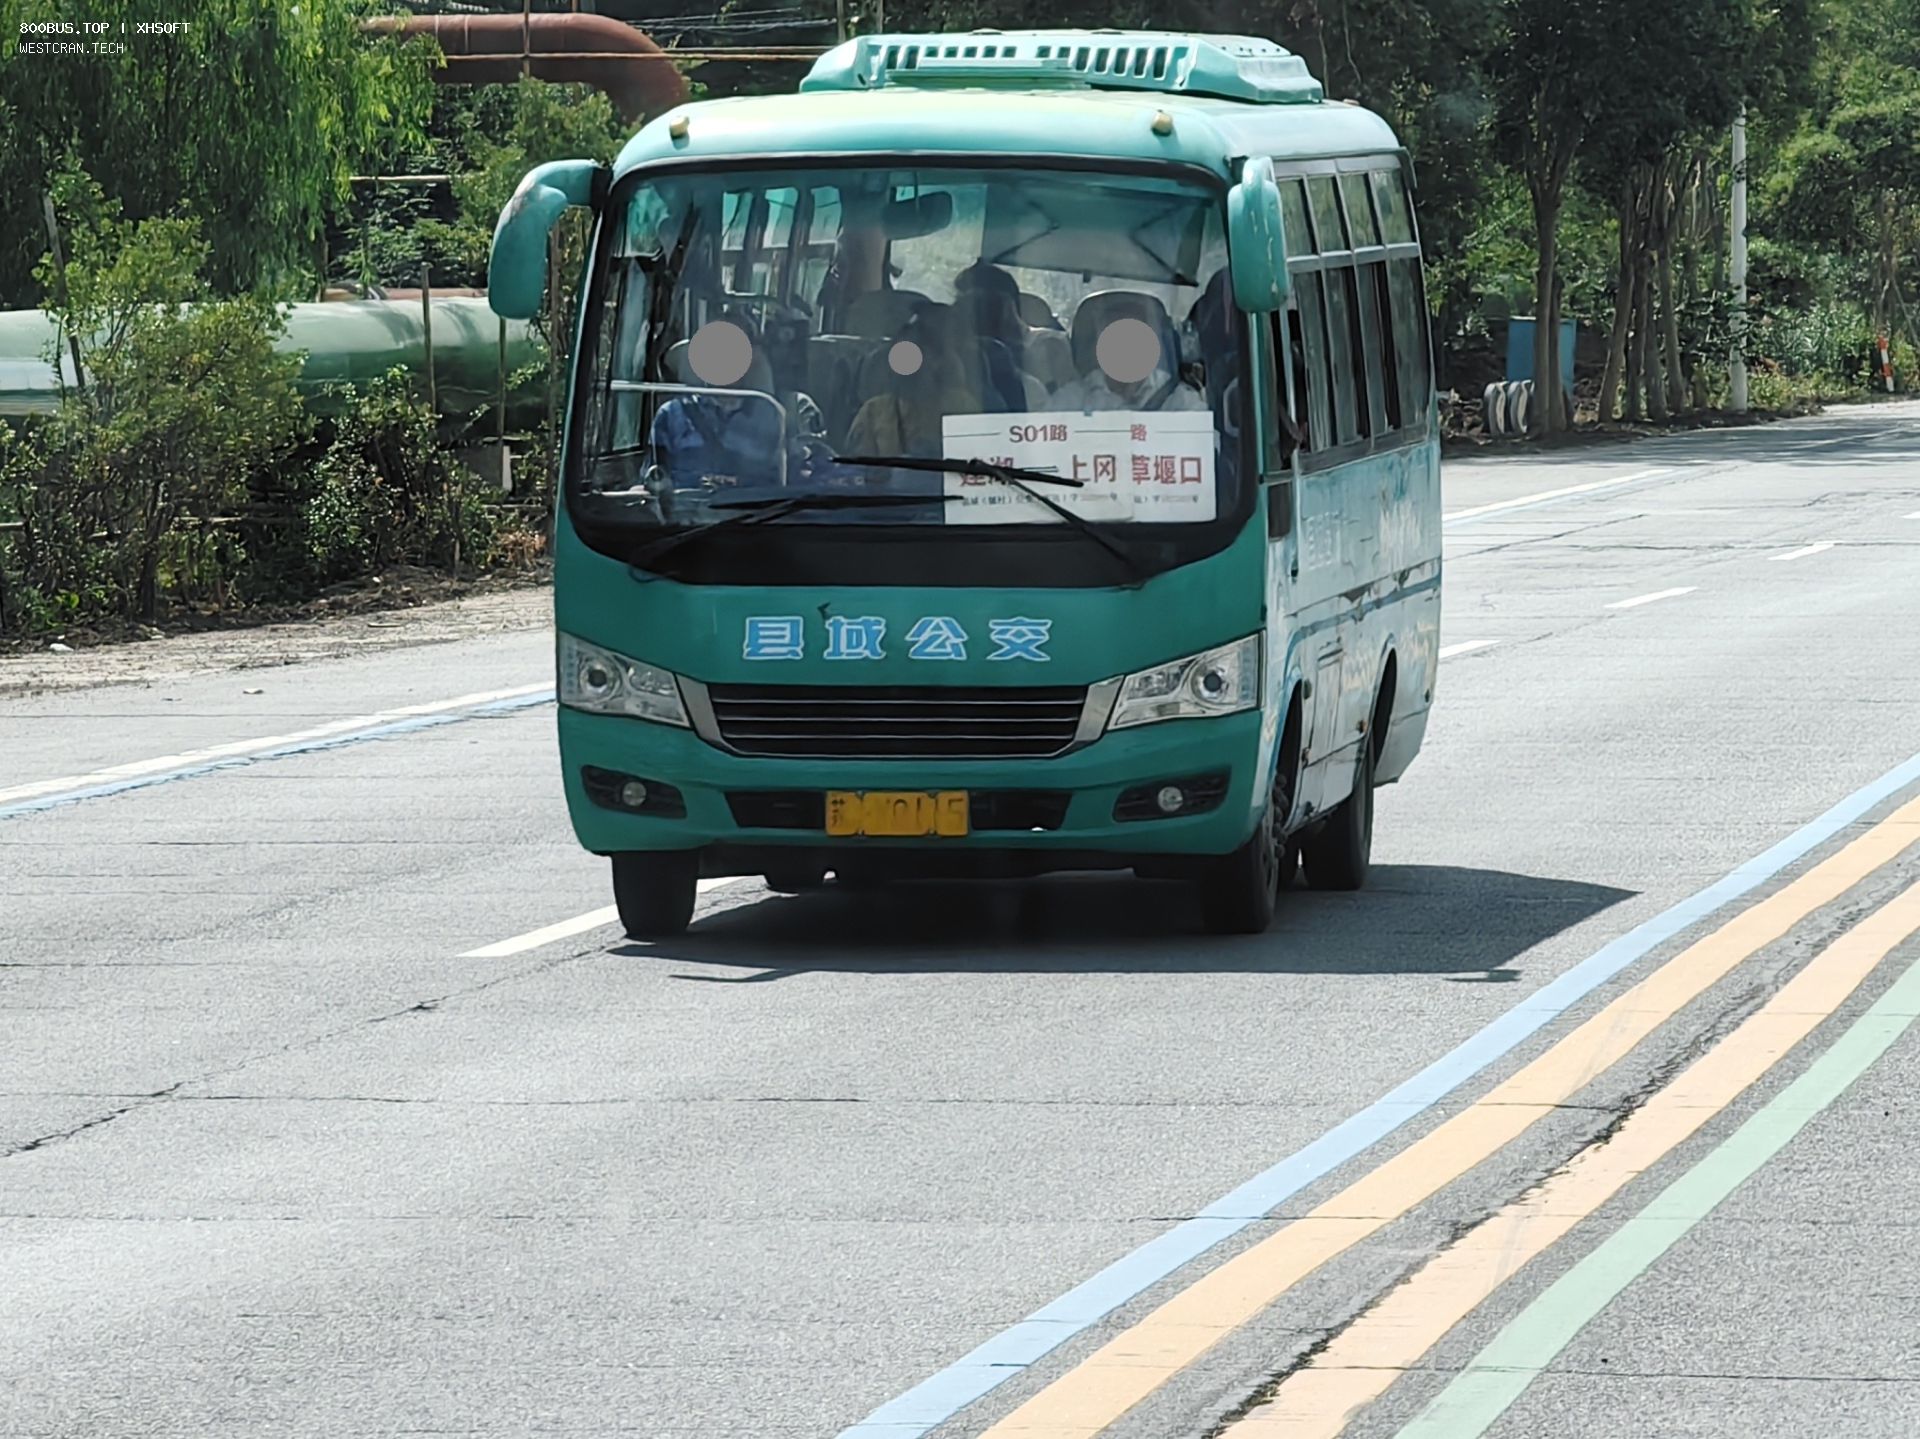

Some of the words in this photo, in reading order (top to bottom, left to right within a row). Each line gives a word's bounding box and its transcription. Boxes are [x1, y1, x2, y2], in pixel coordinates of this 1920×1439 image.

[1009, 424, 1067, 443] S01路
[1130, 424, 1147, 441] 路
[742, 616, 1053, 660] 县域公交
